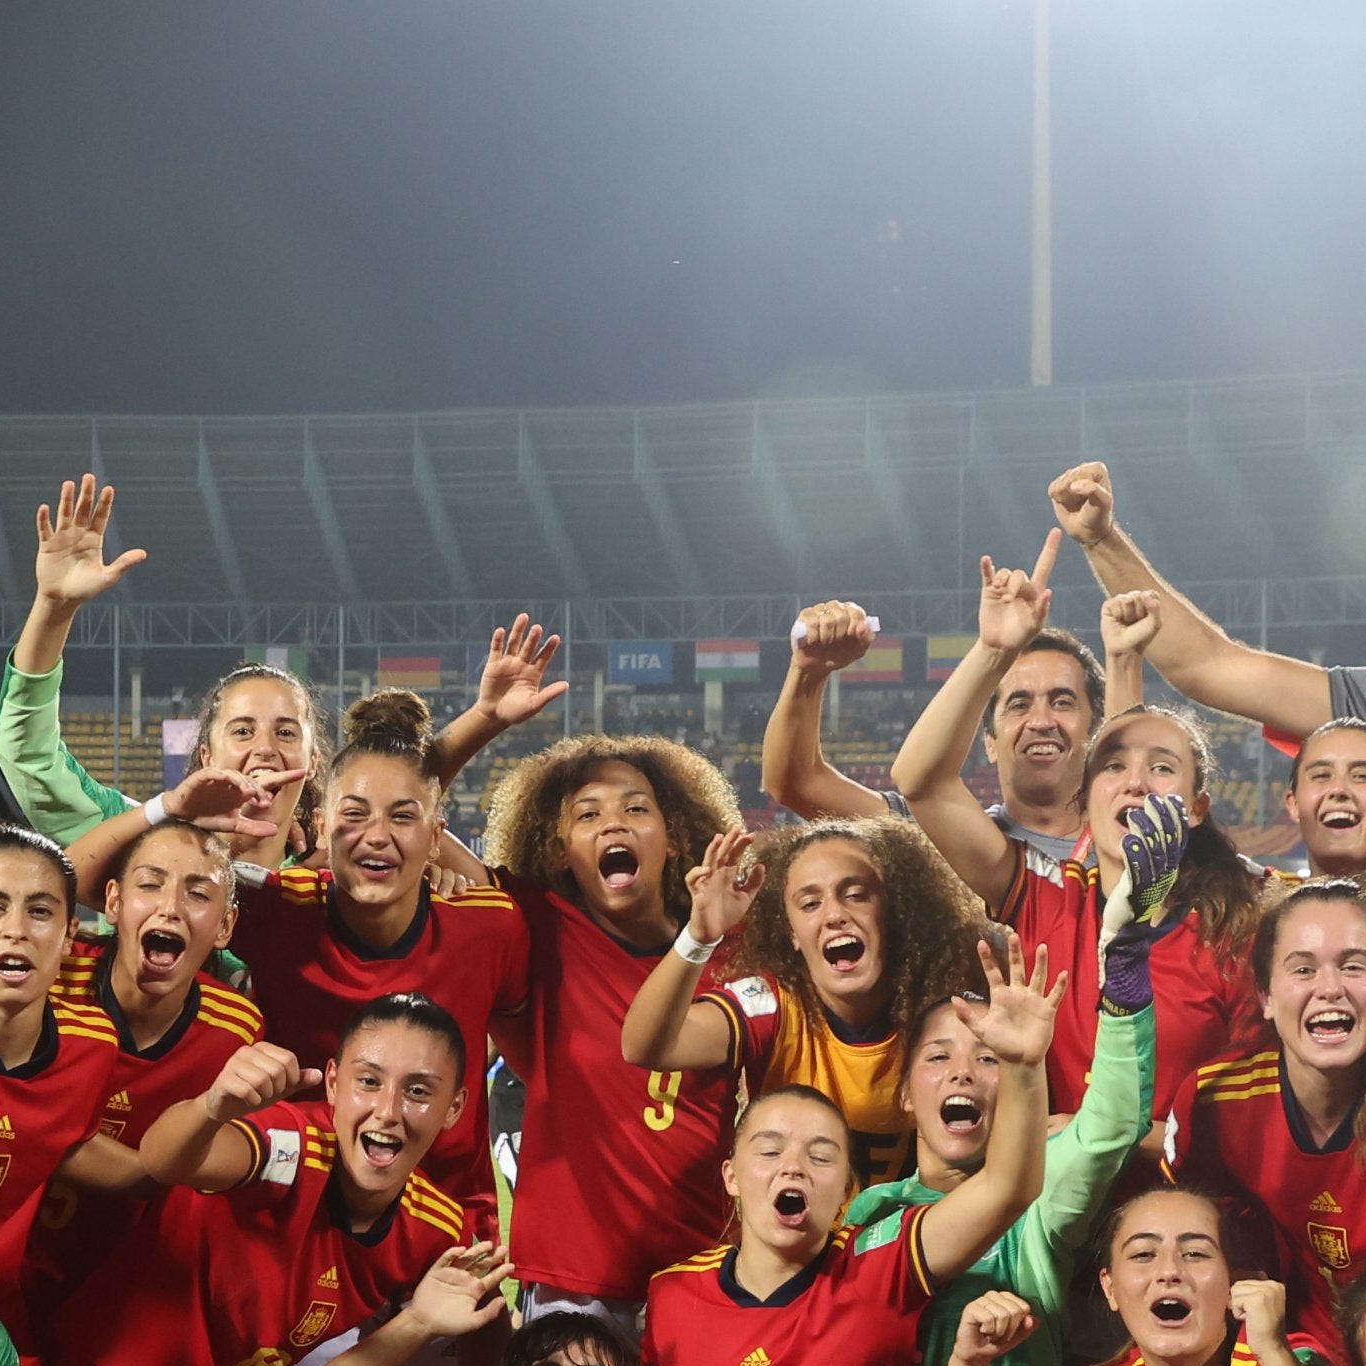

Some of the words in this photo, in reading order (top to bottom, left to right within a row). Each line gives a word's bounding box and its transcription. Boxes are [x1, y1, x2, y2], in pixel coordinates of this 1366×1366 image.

[619, 653, 662, 670] FIFA
[644, 1070, 682, 1131] 9
[1309, 1204, 1343, 1213] adidas
